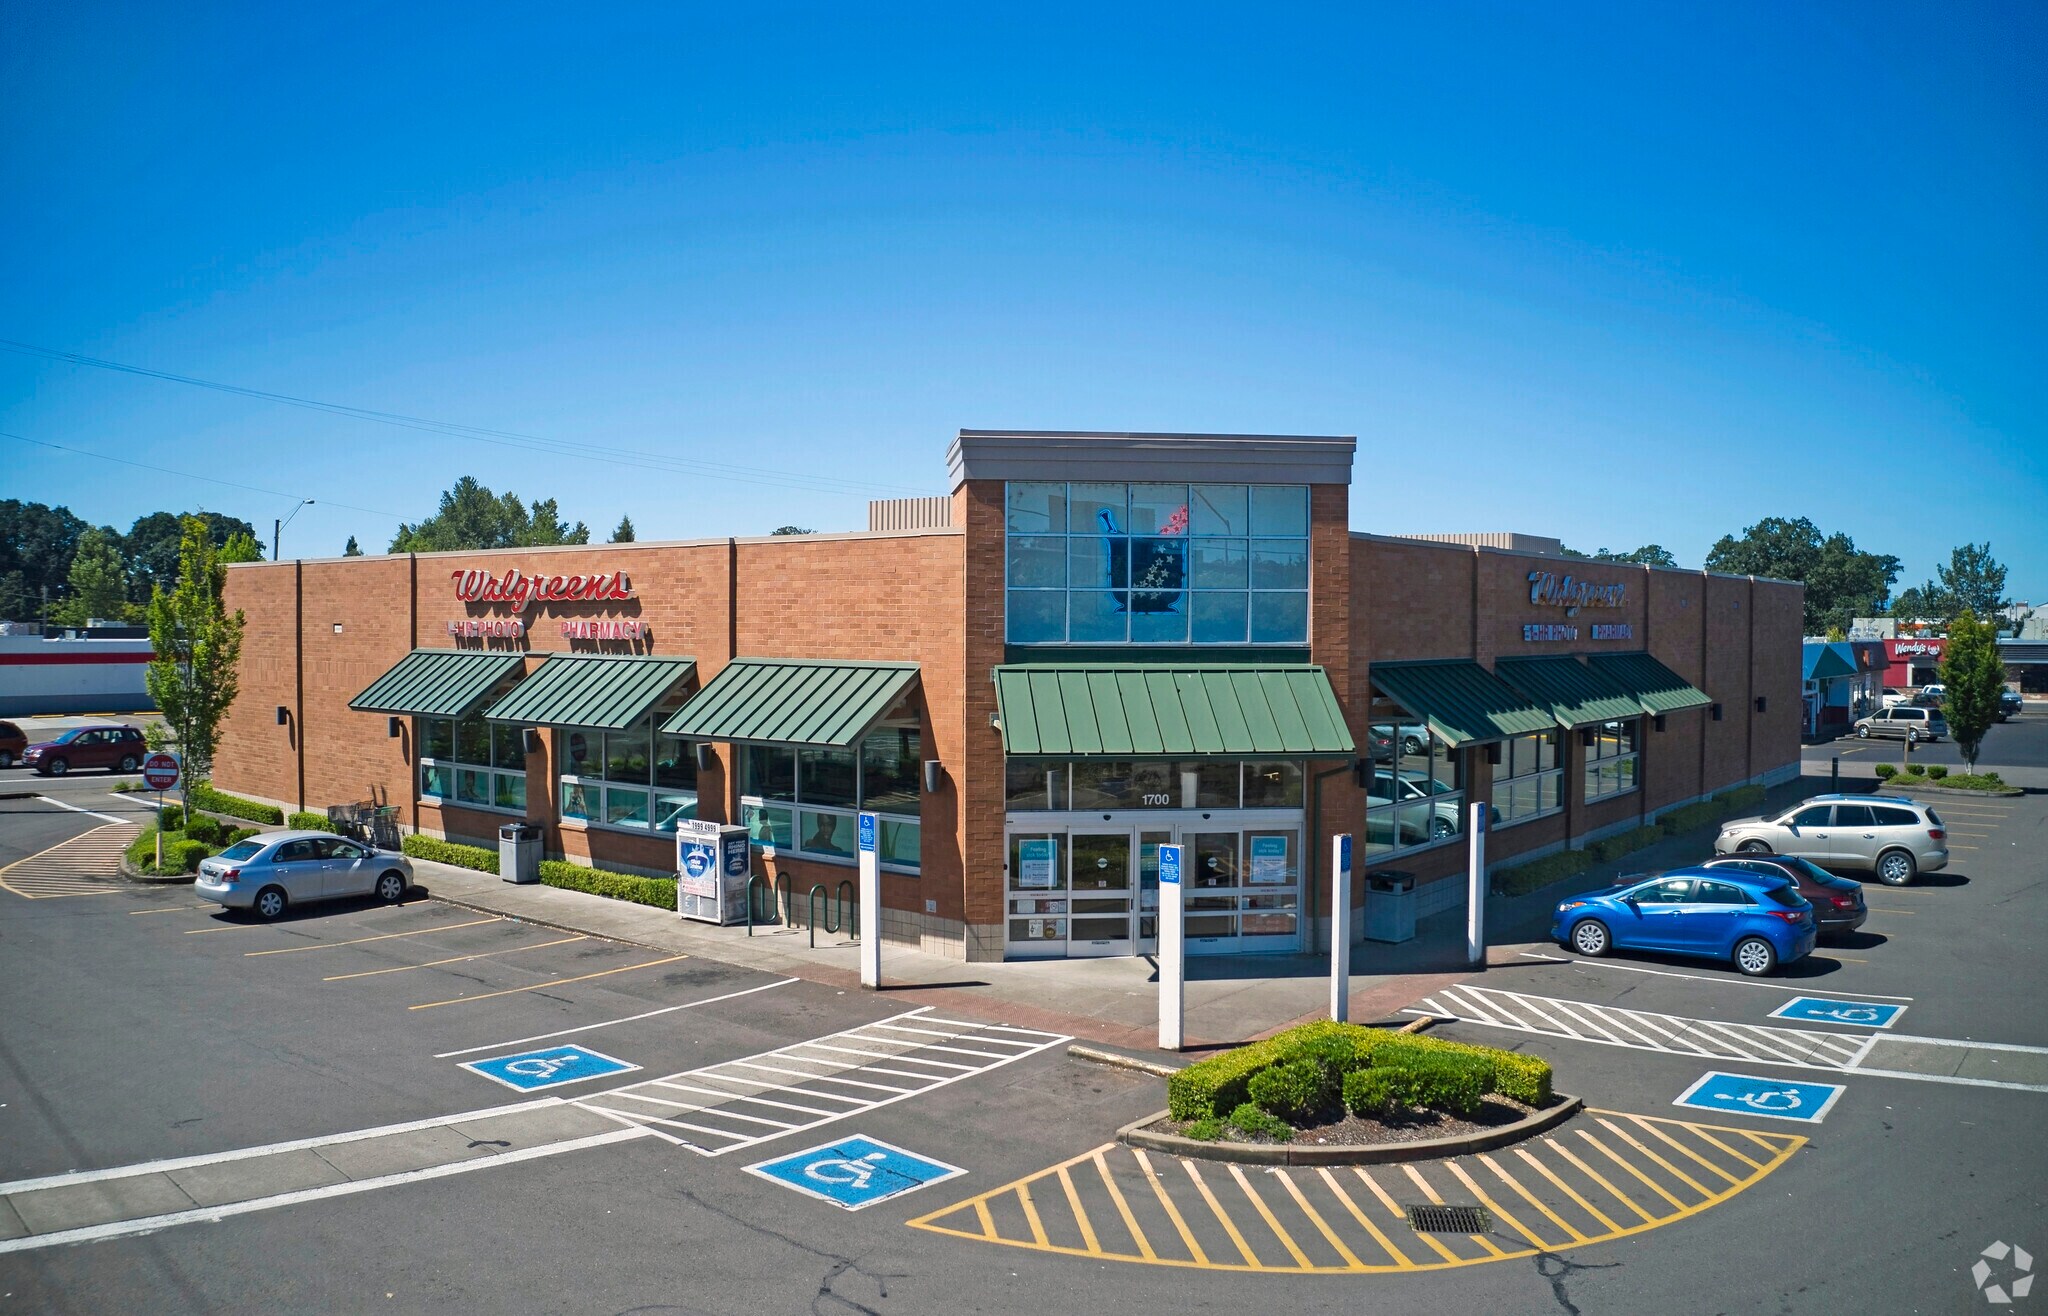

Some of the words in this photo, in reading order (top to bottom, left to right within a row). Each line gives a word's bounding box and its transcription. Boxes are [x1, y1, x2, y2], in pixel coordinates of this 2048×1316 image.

[451, 568, 634, 613] Walgreens
[477, 620, 522, 638] PHOTO
[561, 621, 643, 640] PHARMACY
[1895, 641, 1926, 655] Wendy's
[1142, 794, 1170, 805] 1700
